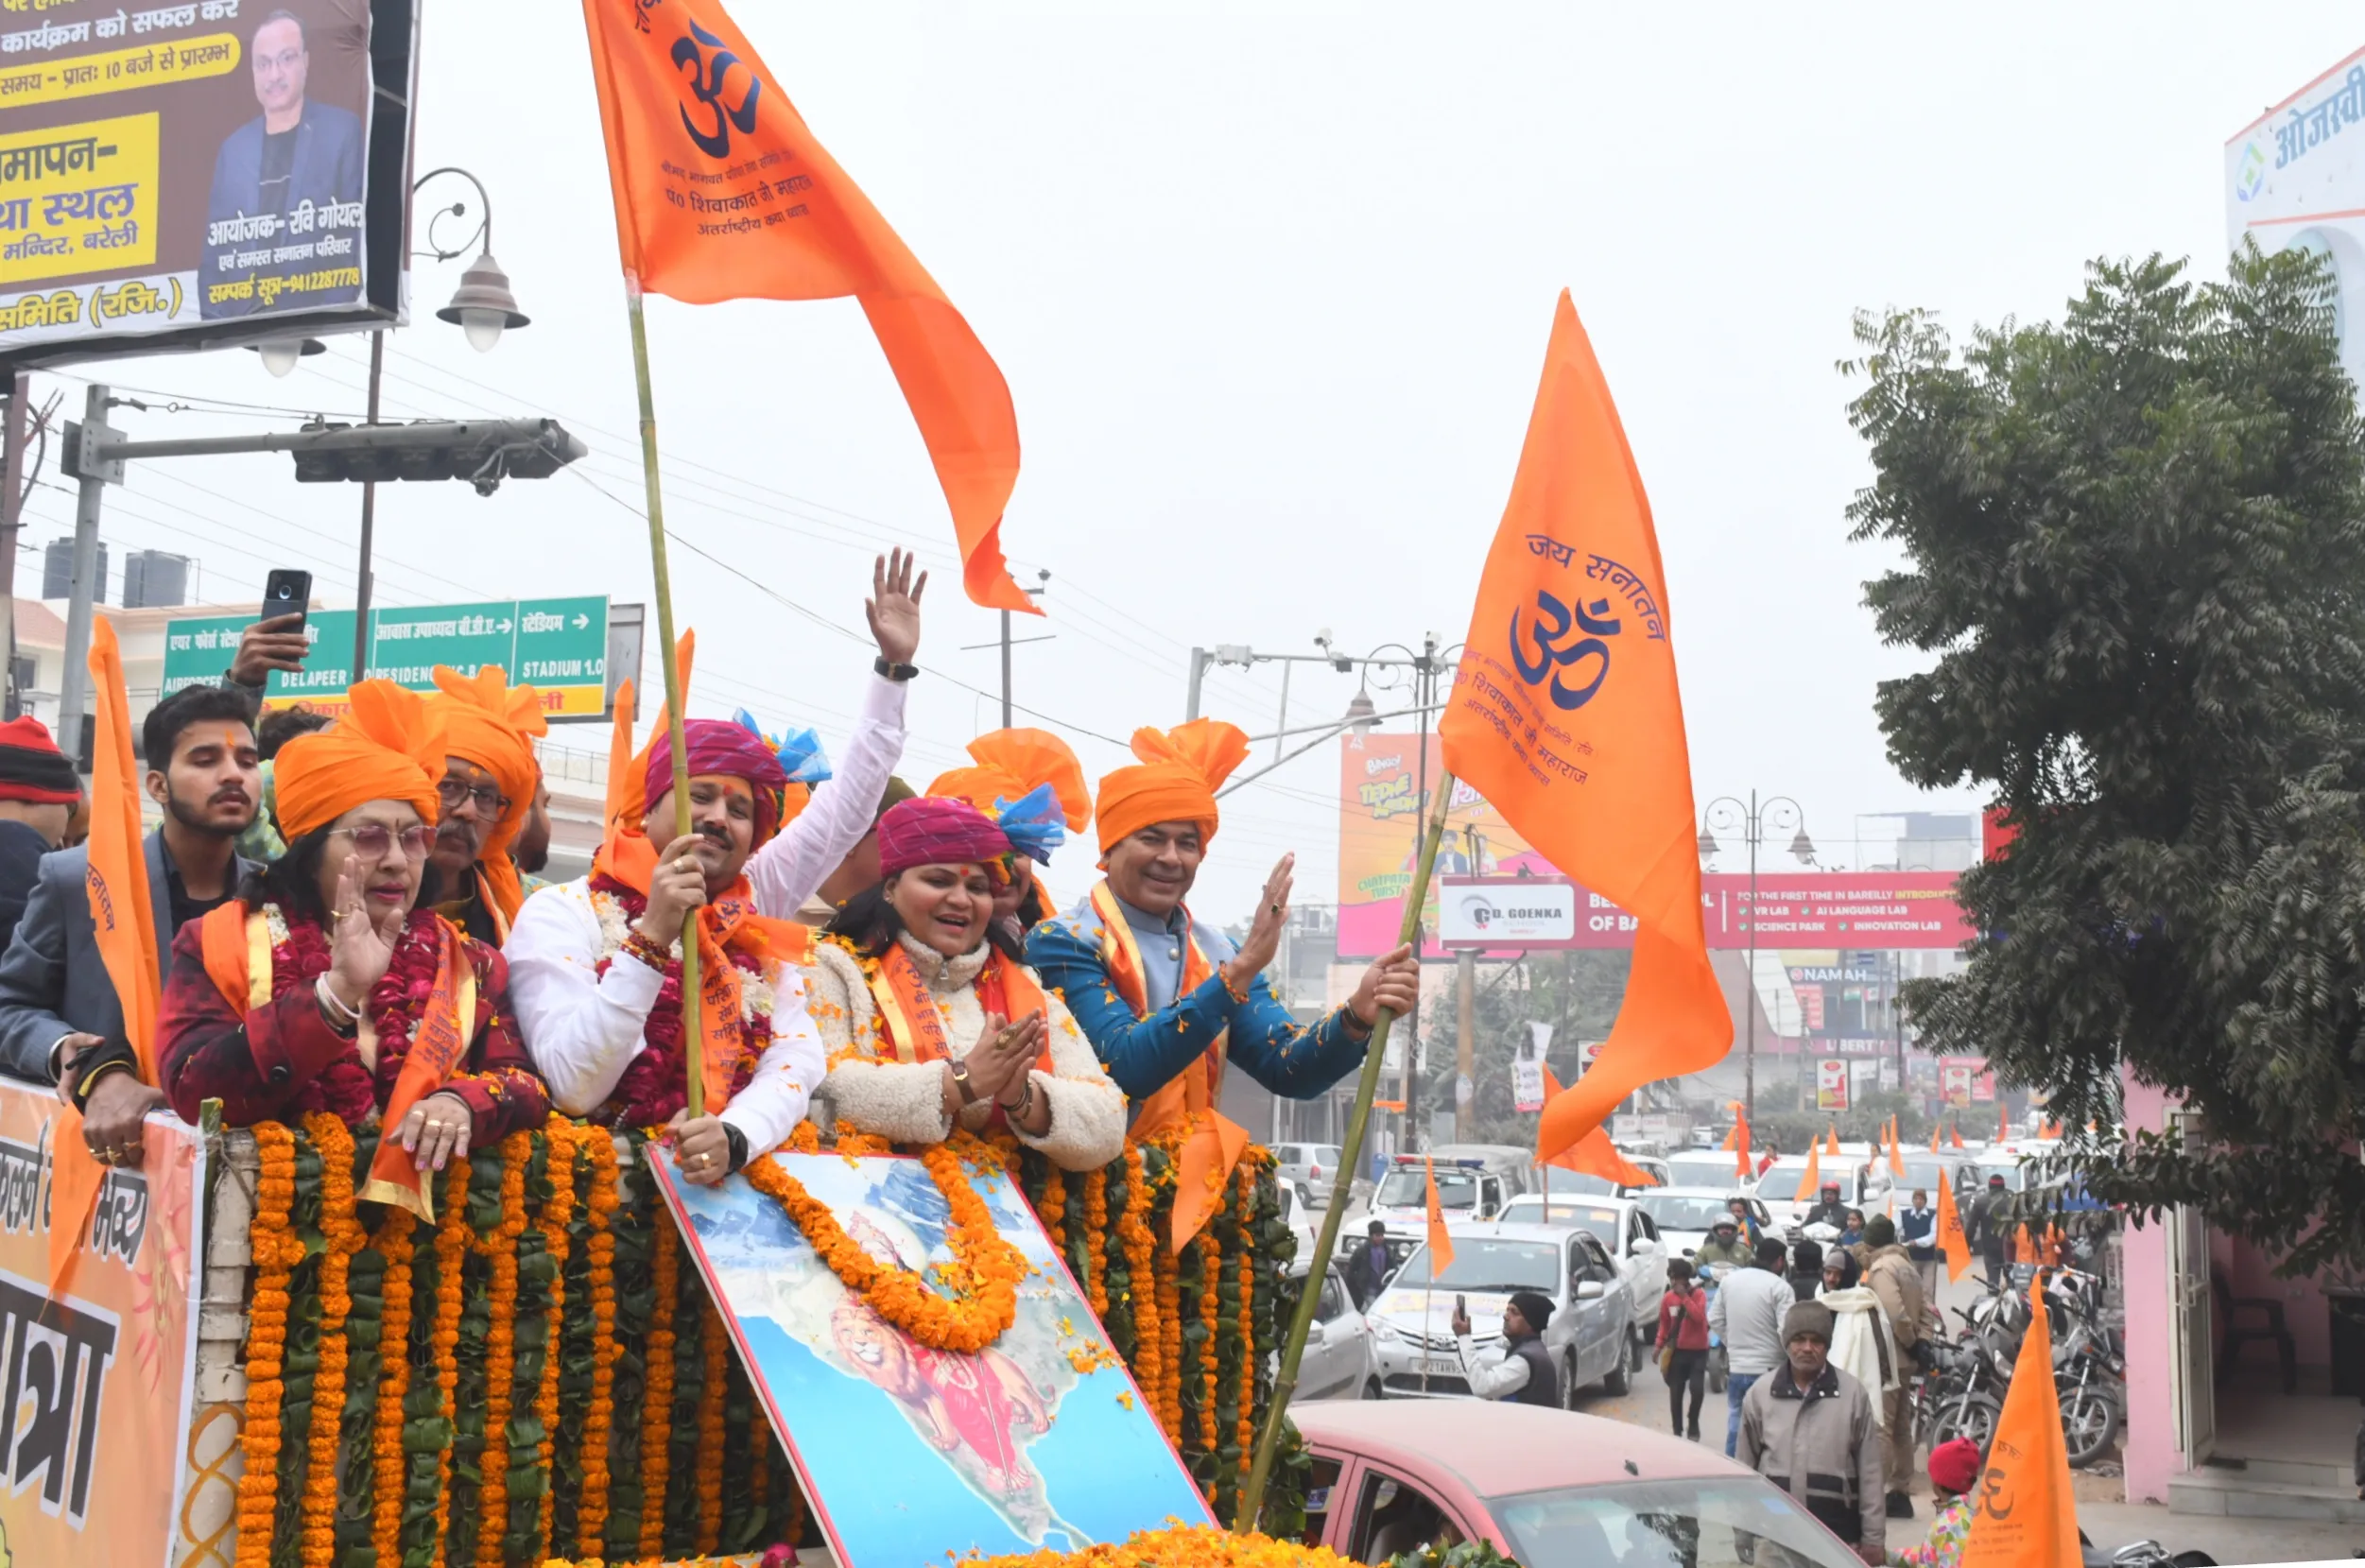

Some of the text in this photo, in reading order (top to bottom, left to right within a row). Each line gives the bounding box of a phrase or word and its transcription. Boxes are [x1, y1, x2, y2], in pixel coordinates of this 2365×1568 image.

[1, 20, 91, 52] कार्यक्रम
[95, 9, 128, 39] को
[132, 4, 198, 33] सफल
[1, 73, 42, 95] समय
[126, 49, 154, 76] बजे
[160, 45, 176, 71] से
[0, 137, 118, 181] मापन-
[43, 182, 139, 227] स्थल
[289, 198, 316, 235] रवि
[318, 196, 365, 231] गोयल
[83, 219, 138, 250] बरेली
[316, 234, 353, 258] परिवार
[1525, 534, 1666, 644] जय सनातन
[281, 669, 347, 687] DELAPEER
[523, 662, 582, 678] STADIUM
[1537, 744, 1589, 785] महाराज
[1760, 891, 1779, 901] THE
[1780, 891, 1807, 901] FIRST
[1808, 890, 1833, 900] TIME
[1835, 890, 1846, 900] IN
[1848, 889, 1892, 901] BAREILLY
[1508, 907, 1562, 920] GOENKA
[1754, 906, 1790, 916] VR LAB
[1816, 905, 1908, 916] AI LANGUAGE LAB
[1589, 915, 1614, 931] OF
[1754, 922, 1826, 932] SCIENCE PARK
[1854, 922, 1942, 931] INNOVATION LAB
